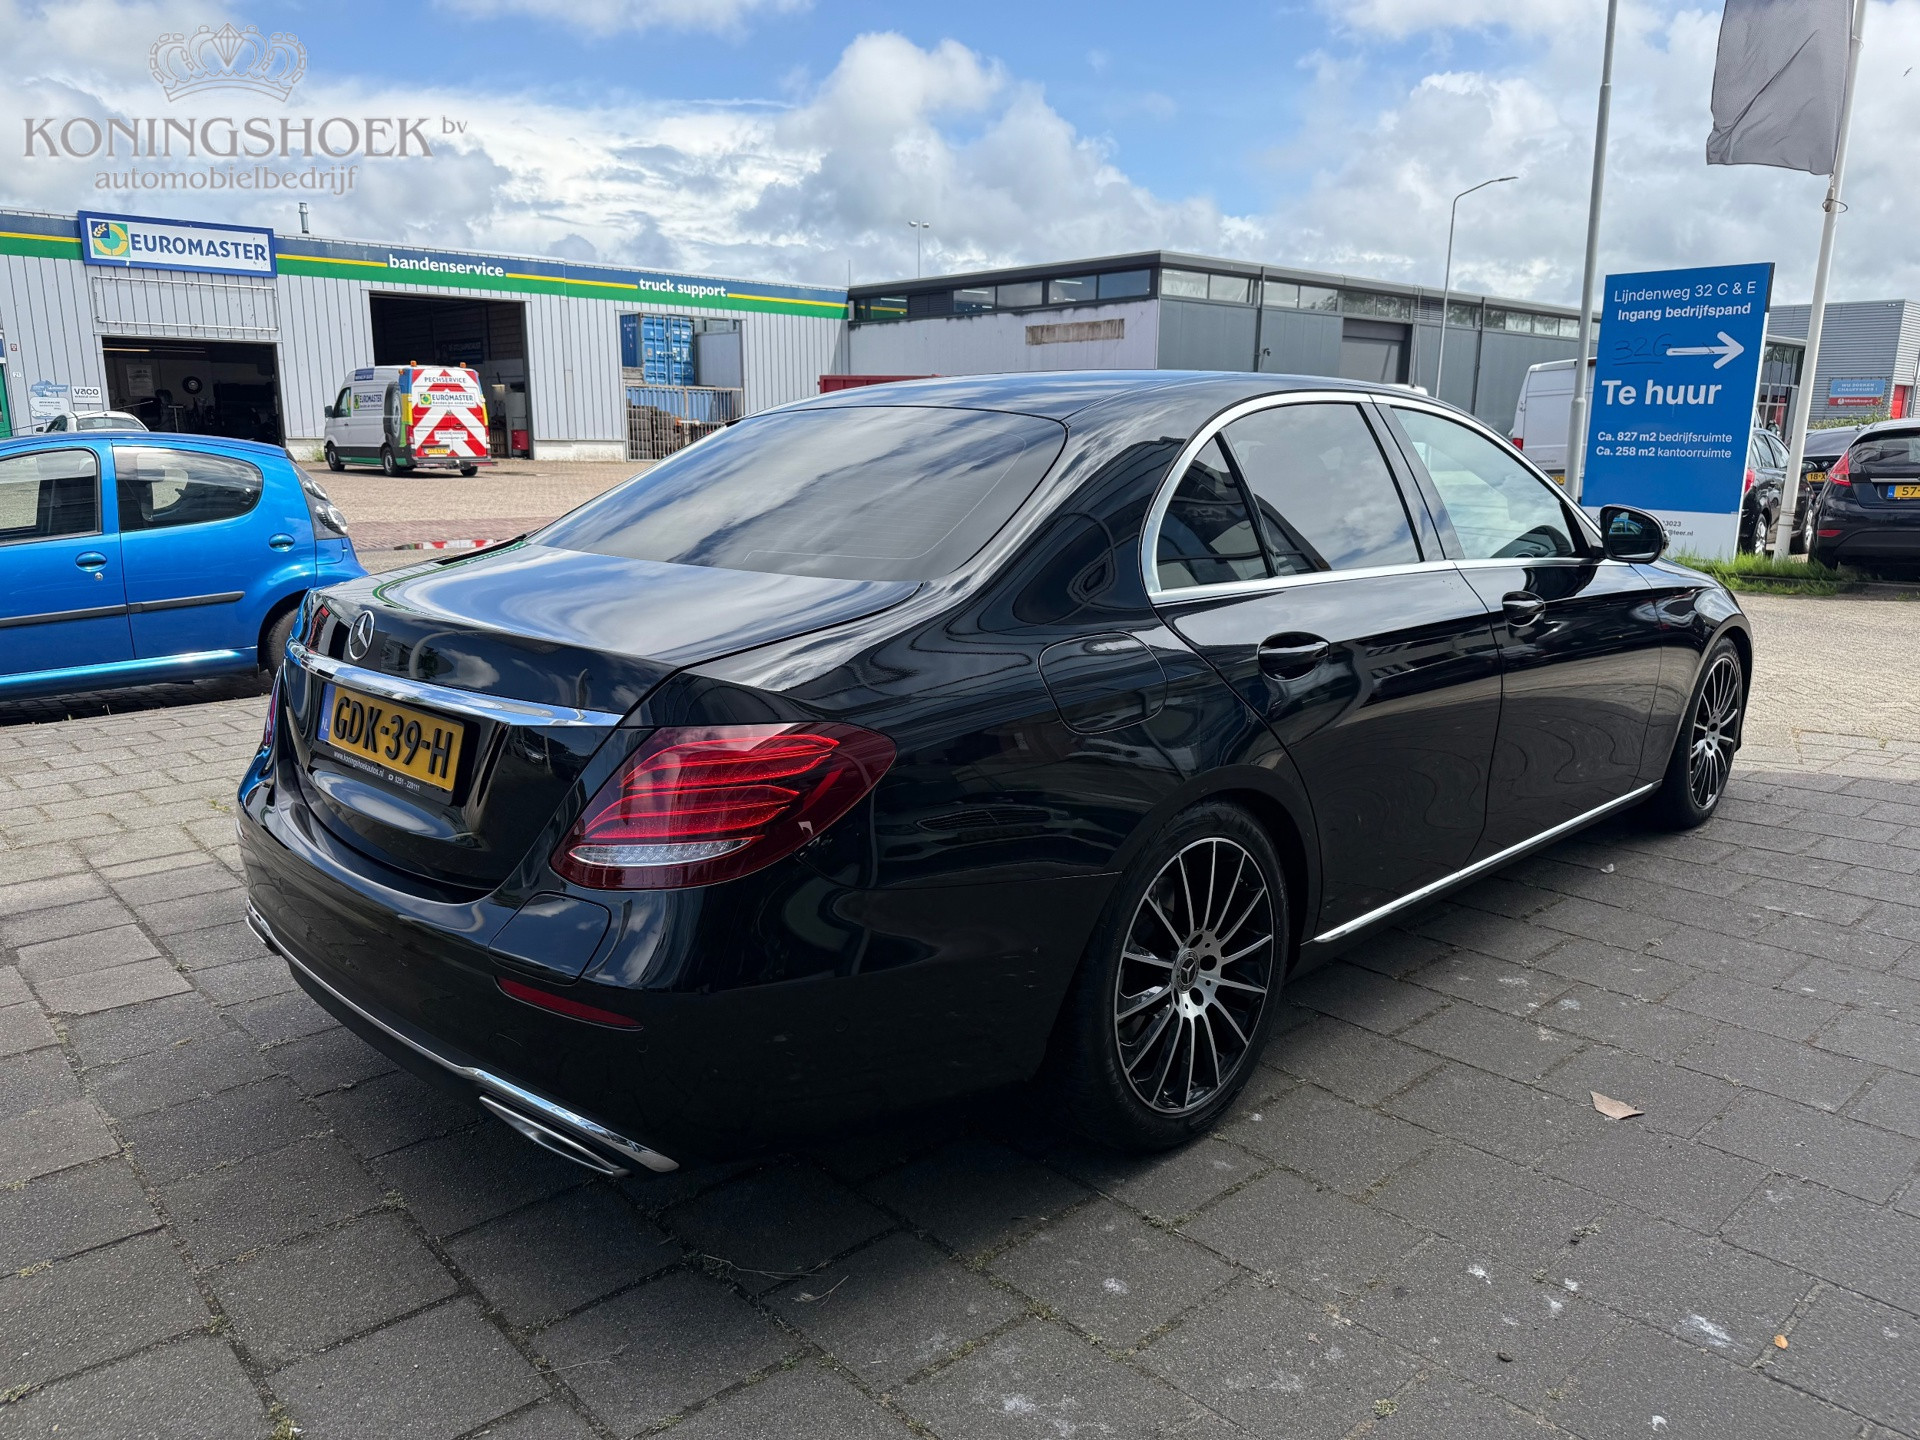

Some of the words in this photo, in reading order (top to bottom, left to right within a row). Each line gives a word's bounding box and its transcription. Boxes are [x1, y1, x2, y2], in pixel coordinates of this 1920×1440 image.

[130, 233, 267, 261] EUROMASTER
[388, 255, 504, 277] bandenservice
[639, 278, 675, 294] truck
[677, 283, 726, 299] support
[1614, 287, 1690, 304] Lijndenweg
[1695, 284, 1713, 298] 32
[1717, 283, 1729, 296] C
[1732, 282, 1743, 295] &
[1747, 281, 1757, 294] E
[1617, 309, 1662, 322] Ingang
[1665, 302, 1752, 319] bedrijfspand
[1602, 379, 1637, 406] Te
[1645, 380, 1722, 405] huur
[1598, 431, 1615, 442] Ca.
[1617, 431, 1637, 442] 827
[1639, 431, 1657, 442] m2
[1658, 431, 1733, 444] bedrijfsruimte
[1596, 446, 1613, 456] Ca.
[1615, 447, 1636, 457] 258
[1638, 447, 1655, 457] m2
[1657, 447, 1732, 459] kantoorruimte
[333, 696, 454, 779] GDK-39-H
